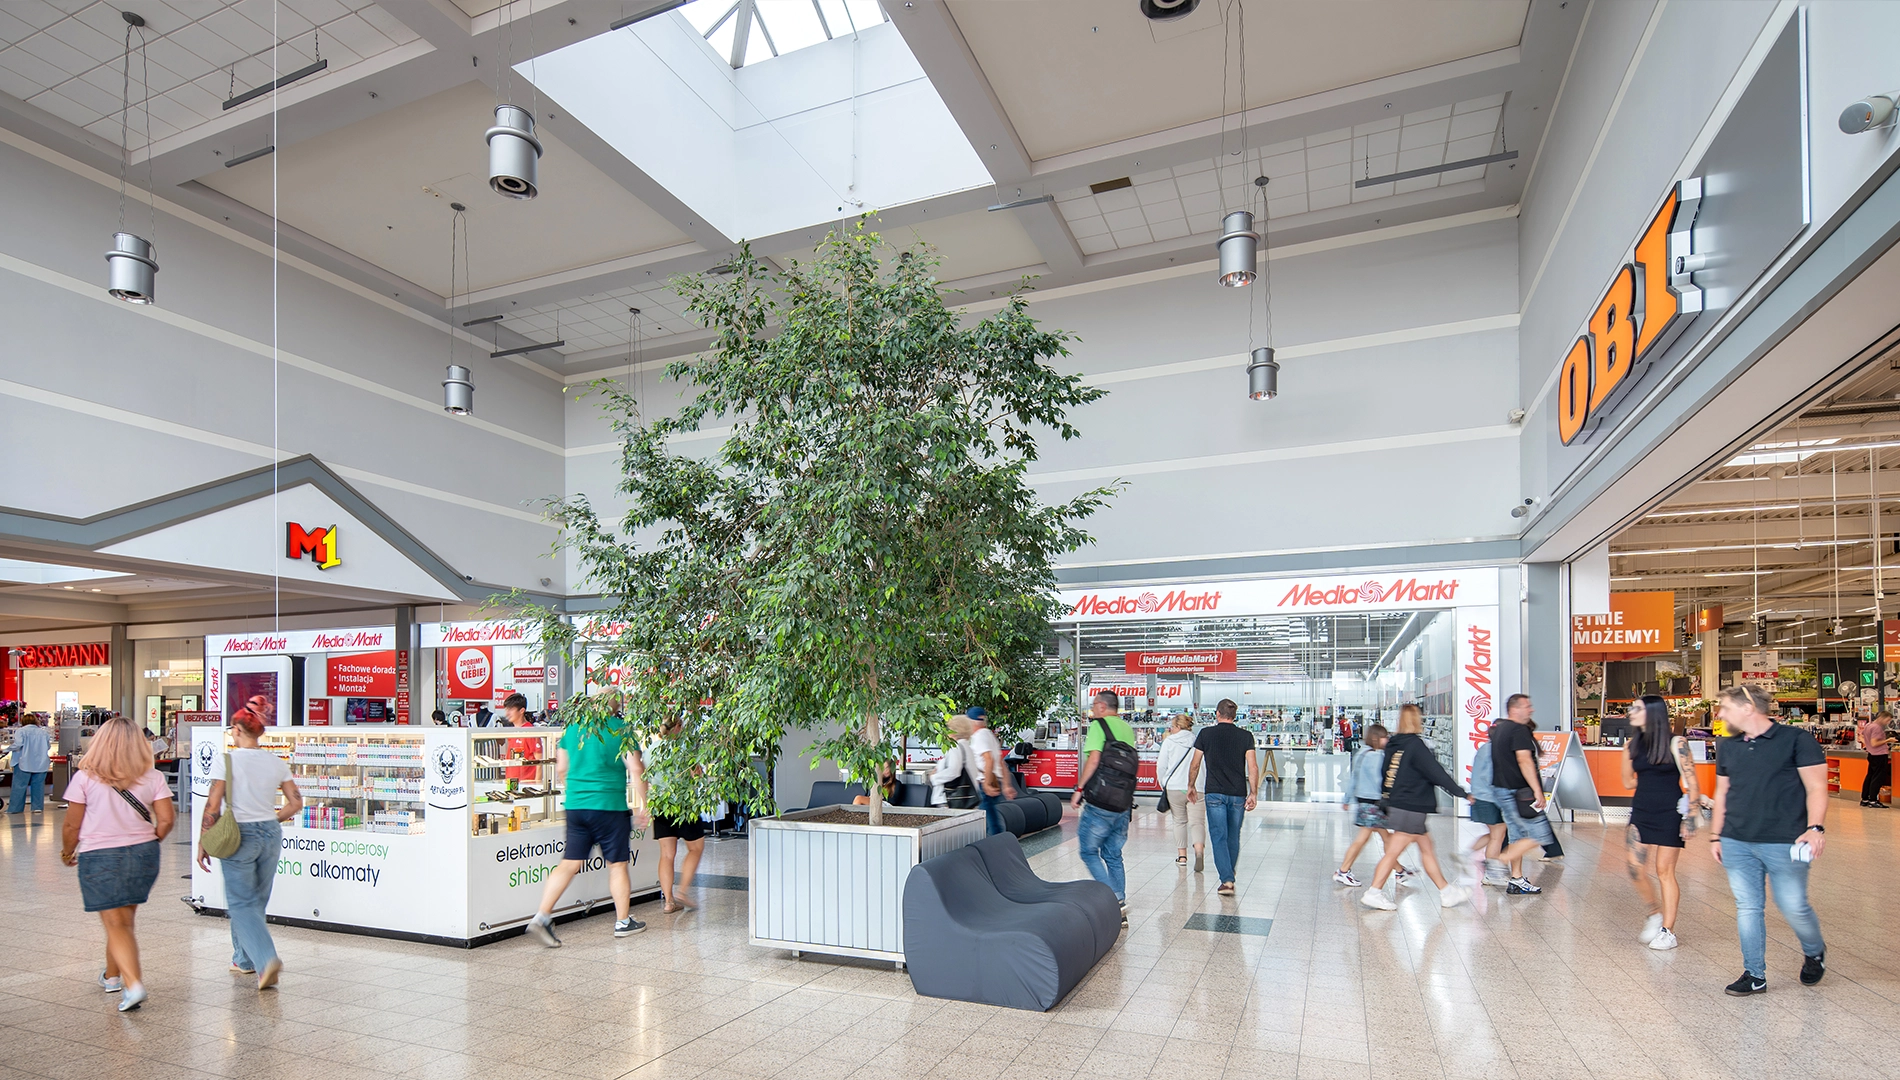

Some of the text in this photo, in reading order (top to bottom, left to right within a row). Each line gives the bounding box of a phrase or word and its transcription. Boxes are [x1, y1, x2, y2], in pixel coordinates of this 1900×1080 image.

[1558, 186, 1680, 446] OBI
[285, 521, 342, 570] M1
[1276, 578, 1460, 607] Media Markt
[1068, 590, 1222, 615] Media Markt
[312, 632, 383, 649] Media Markt
[442, 624, 525, 642] Media Markt
[1573, 628, 1660, 645] MOŻEMY!
[223, 636, 287, 652] Media Markt
[16, 643, 109, 668] ROSSMANN
[459, 657, 484, 667] ZROBIMY
[1142, 654, 1219, 665] Usługi MediaMarkt
[1464, 624, 1492, 700] Markt
[338, 664, 397, 674] Fachowe doradz
[461, 667, 487, 681] CIEBIE!
[1156, 665, 1205, 673] Fotolaboratorium
[209, 667, 219, 708] Markt
[338, 674, 374, 684] Instalacja
[338, 684, 367, 693] Montaż
[281, 835, 389, 860] oniczne papierosy
[495, 839, 566, 863] elektronic
[277, 856, 381, 887] sha alkomaty
